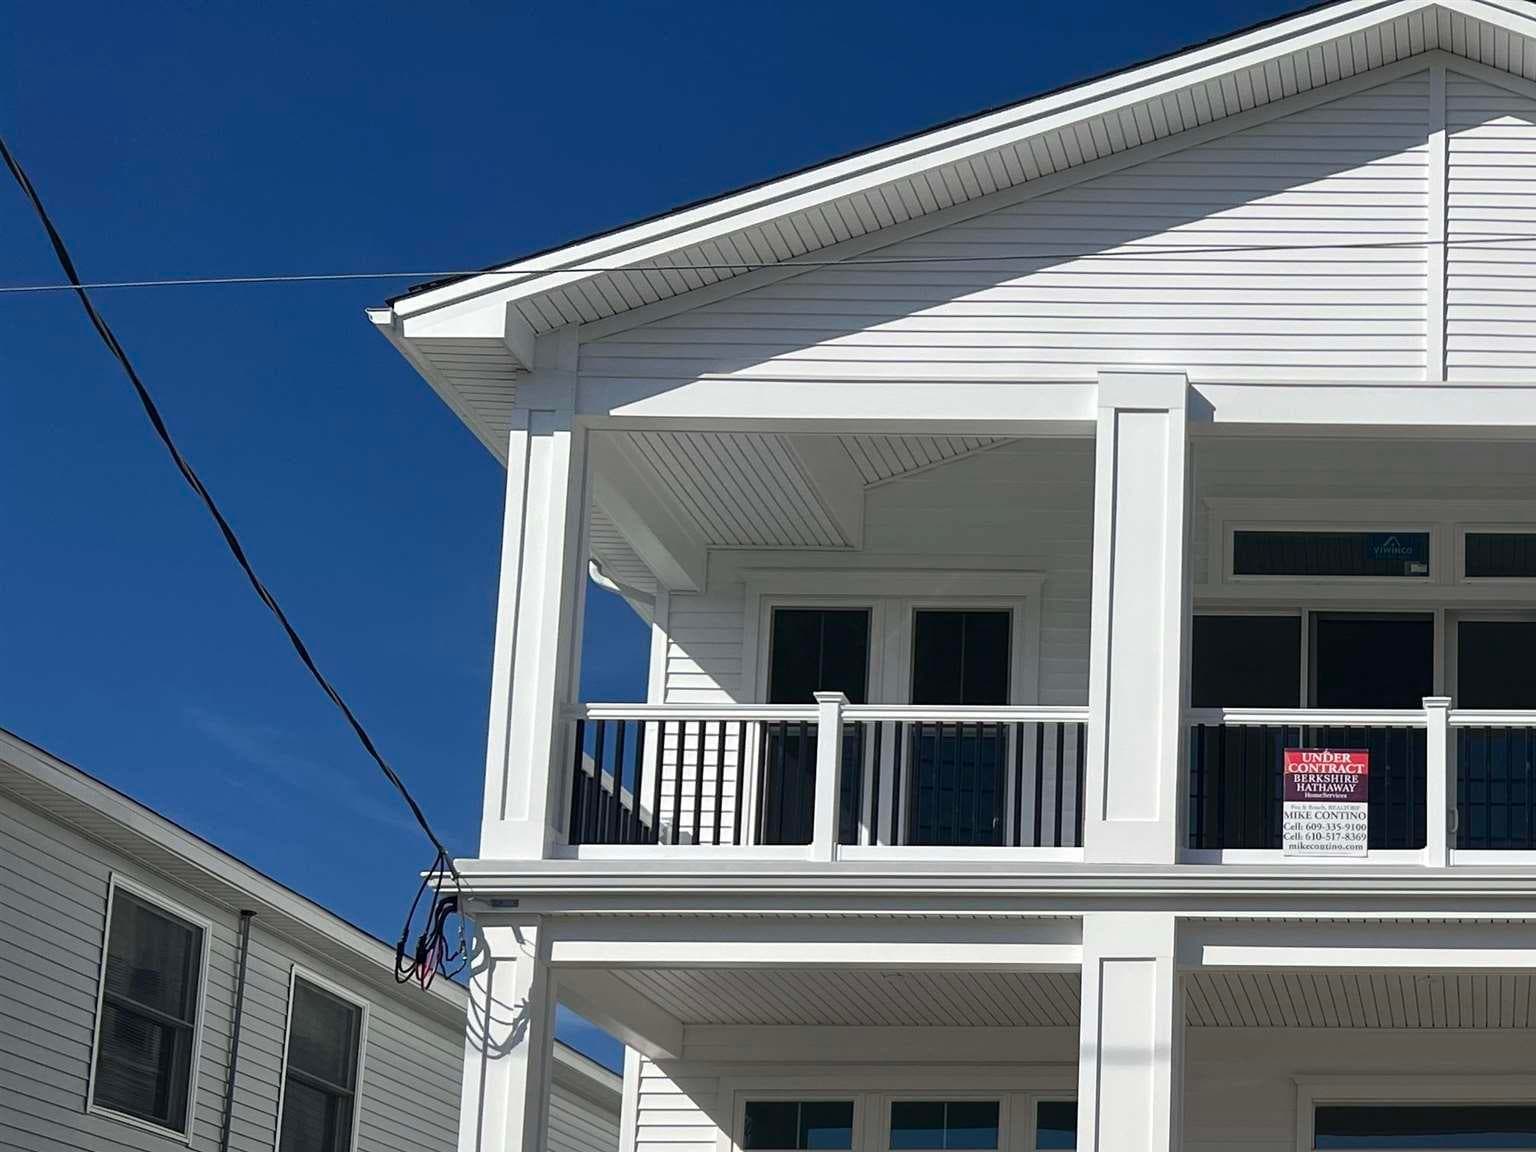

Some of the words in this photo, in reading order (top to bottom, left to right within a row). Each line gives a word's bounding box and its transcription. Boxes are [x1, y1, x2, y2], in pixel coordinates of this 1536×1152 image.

[1302, 753, 1351, 763] UNDER
[1288, 763, 1365, 774] CONTRACT
[1294, 774, 1359, 784] BERKSHIRE
[1297, 783, 1356, 792] HATHAWAY
[1284, 811, 1312, 820] MIKE
[1314, 811, 1366, 821] CONTINO
[1283, 822, 1304, 831] Cell:
[1305, 822, 1367, 831] 609-335-9100
[1283, 832, 1304, 841] Cell:
[1305, 832, 1367, 841] 610-517-8369
